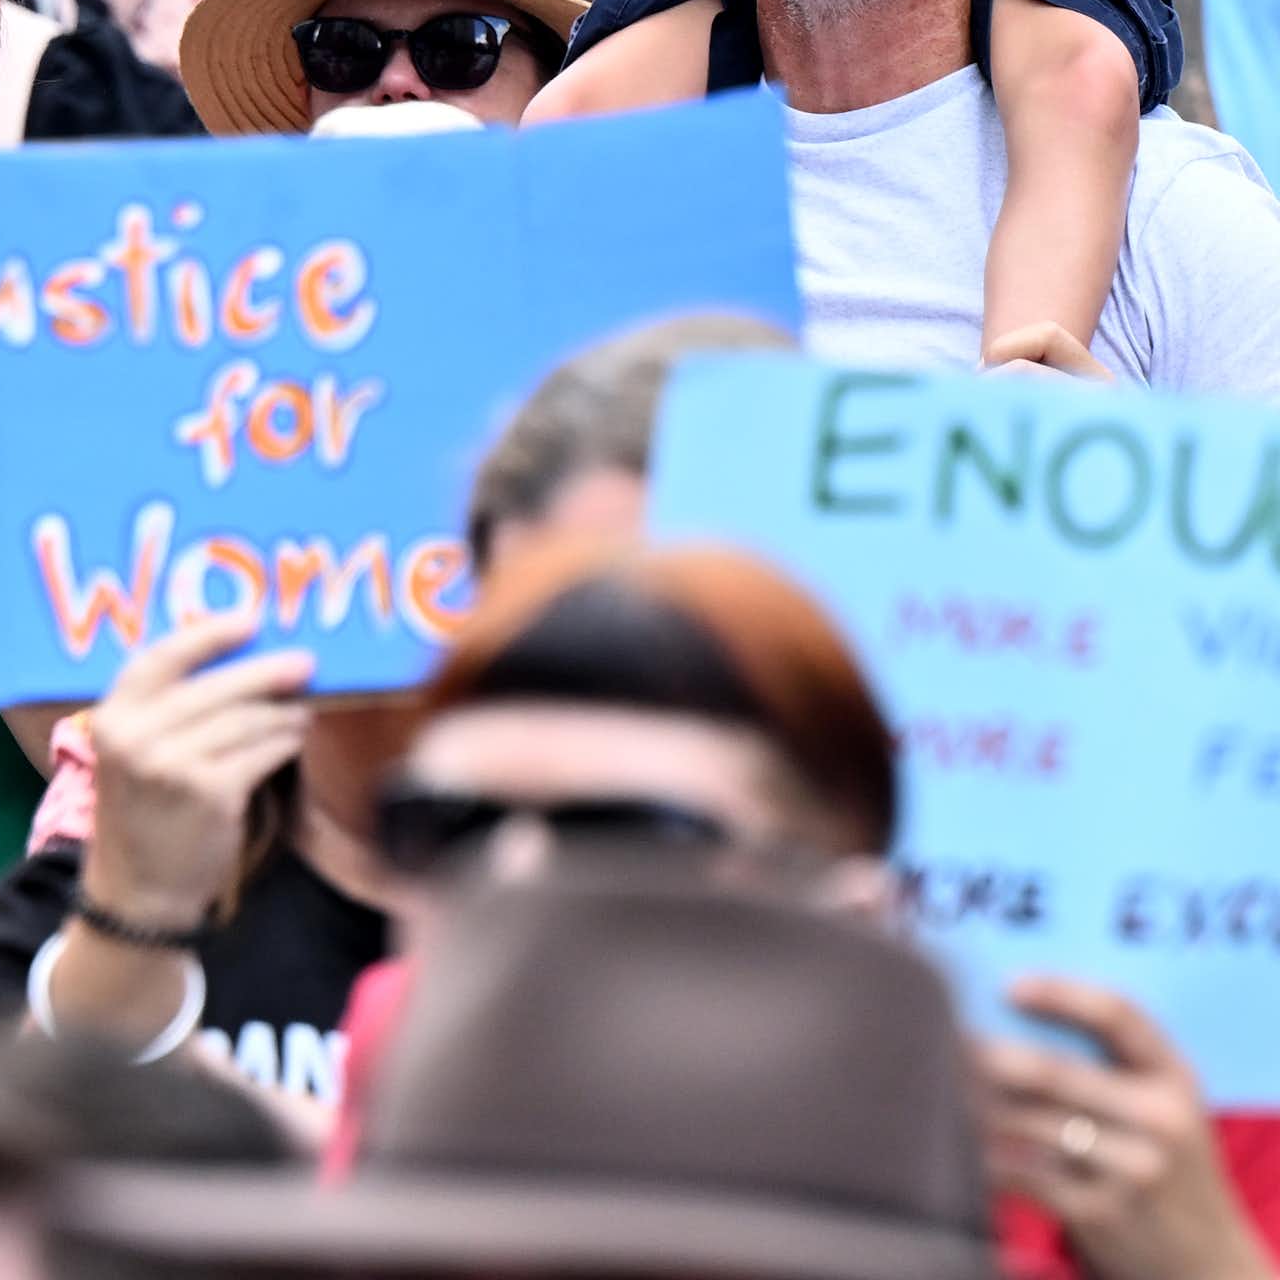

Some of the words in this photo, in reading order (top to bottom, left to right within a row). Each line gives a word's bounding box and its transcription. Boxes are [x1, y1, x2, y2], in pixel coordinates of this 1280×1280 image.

[176, 359, 385, 487] for
[808, 370, 1280, 572] ENOU
[31, 499, 472, 662] Wome
